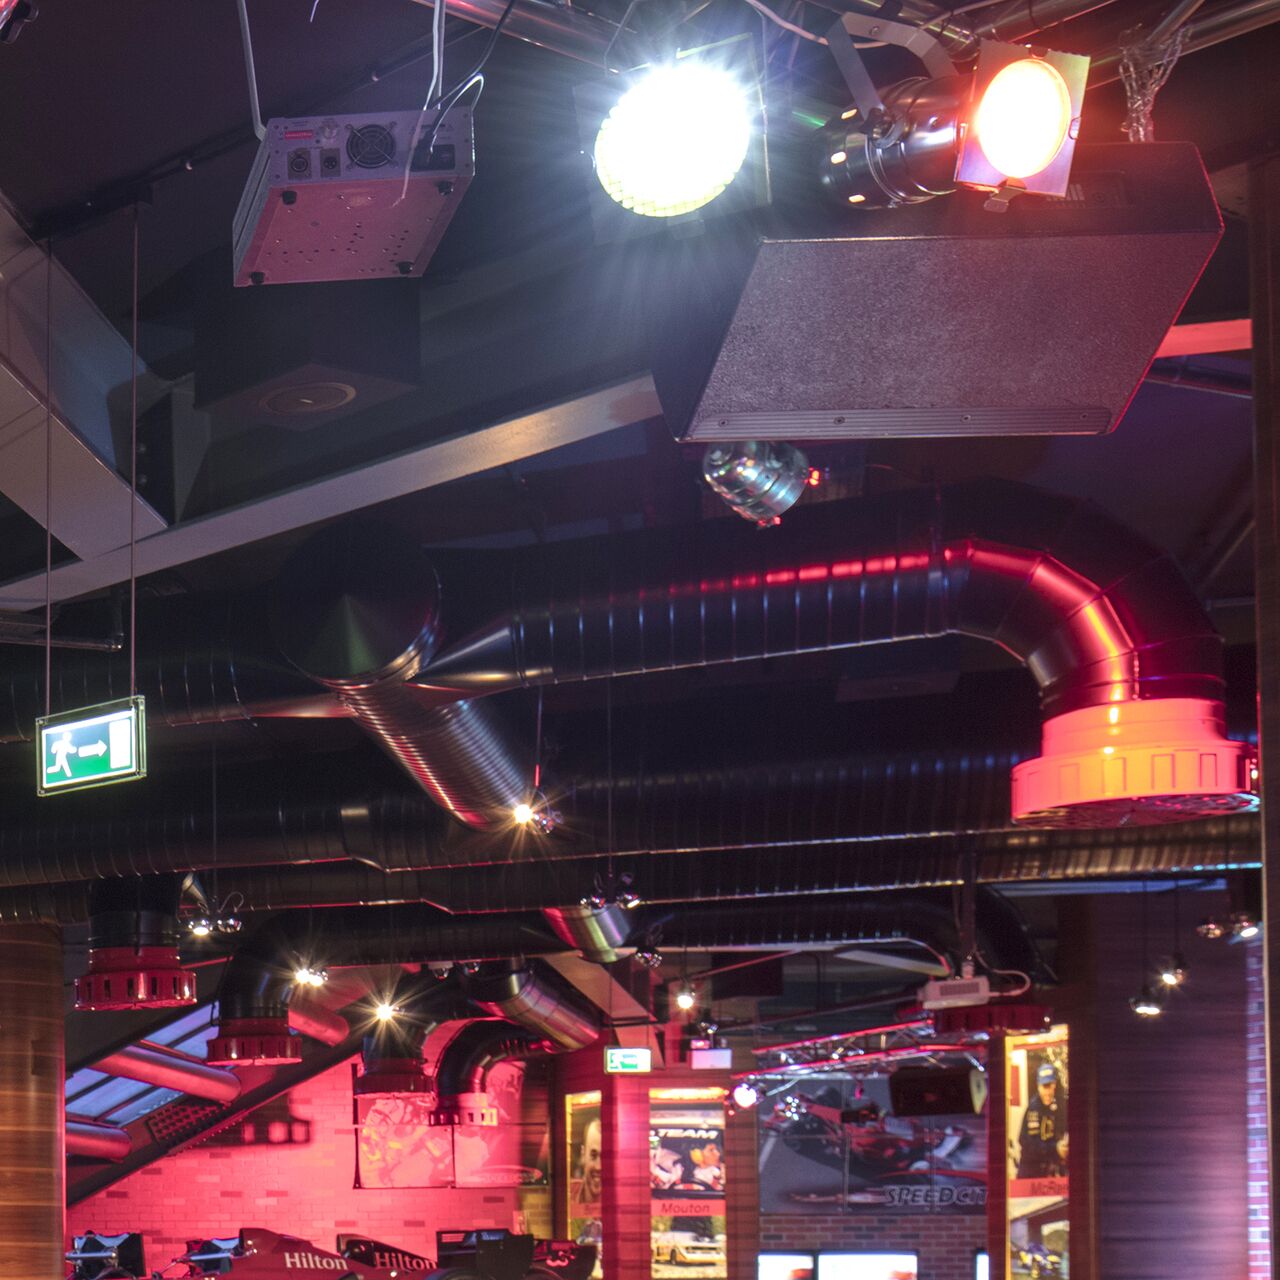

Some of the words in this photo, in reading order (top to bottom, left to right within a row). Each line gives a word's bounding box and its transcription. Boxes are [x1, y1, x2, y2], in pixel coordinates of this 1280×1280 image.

[661, 1202, 710, 1214] Mouton
[284, 1251, 349, 1271] Hilton
[374, 1251, 438, 1271] Hilton
